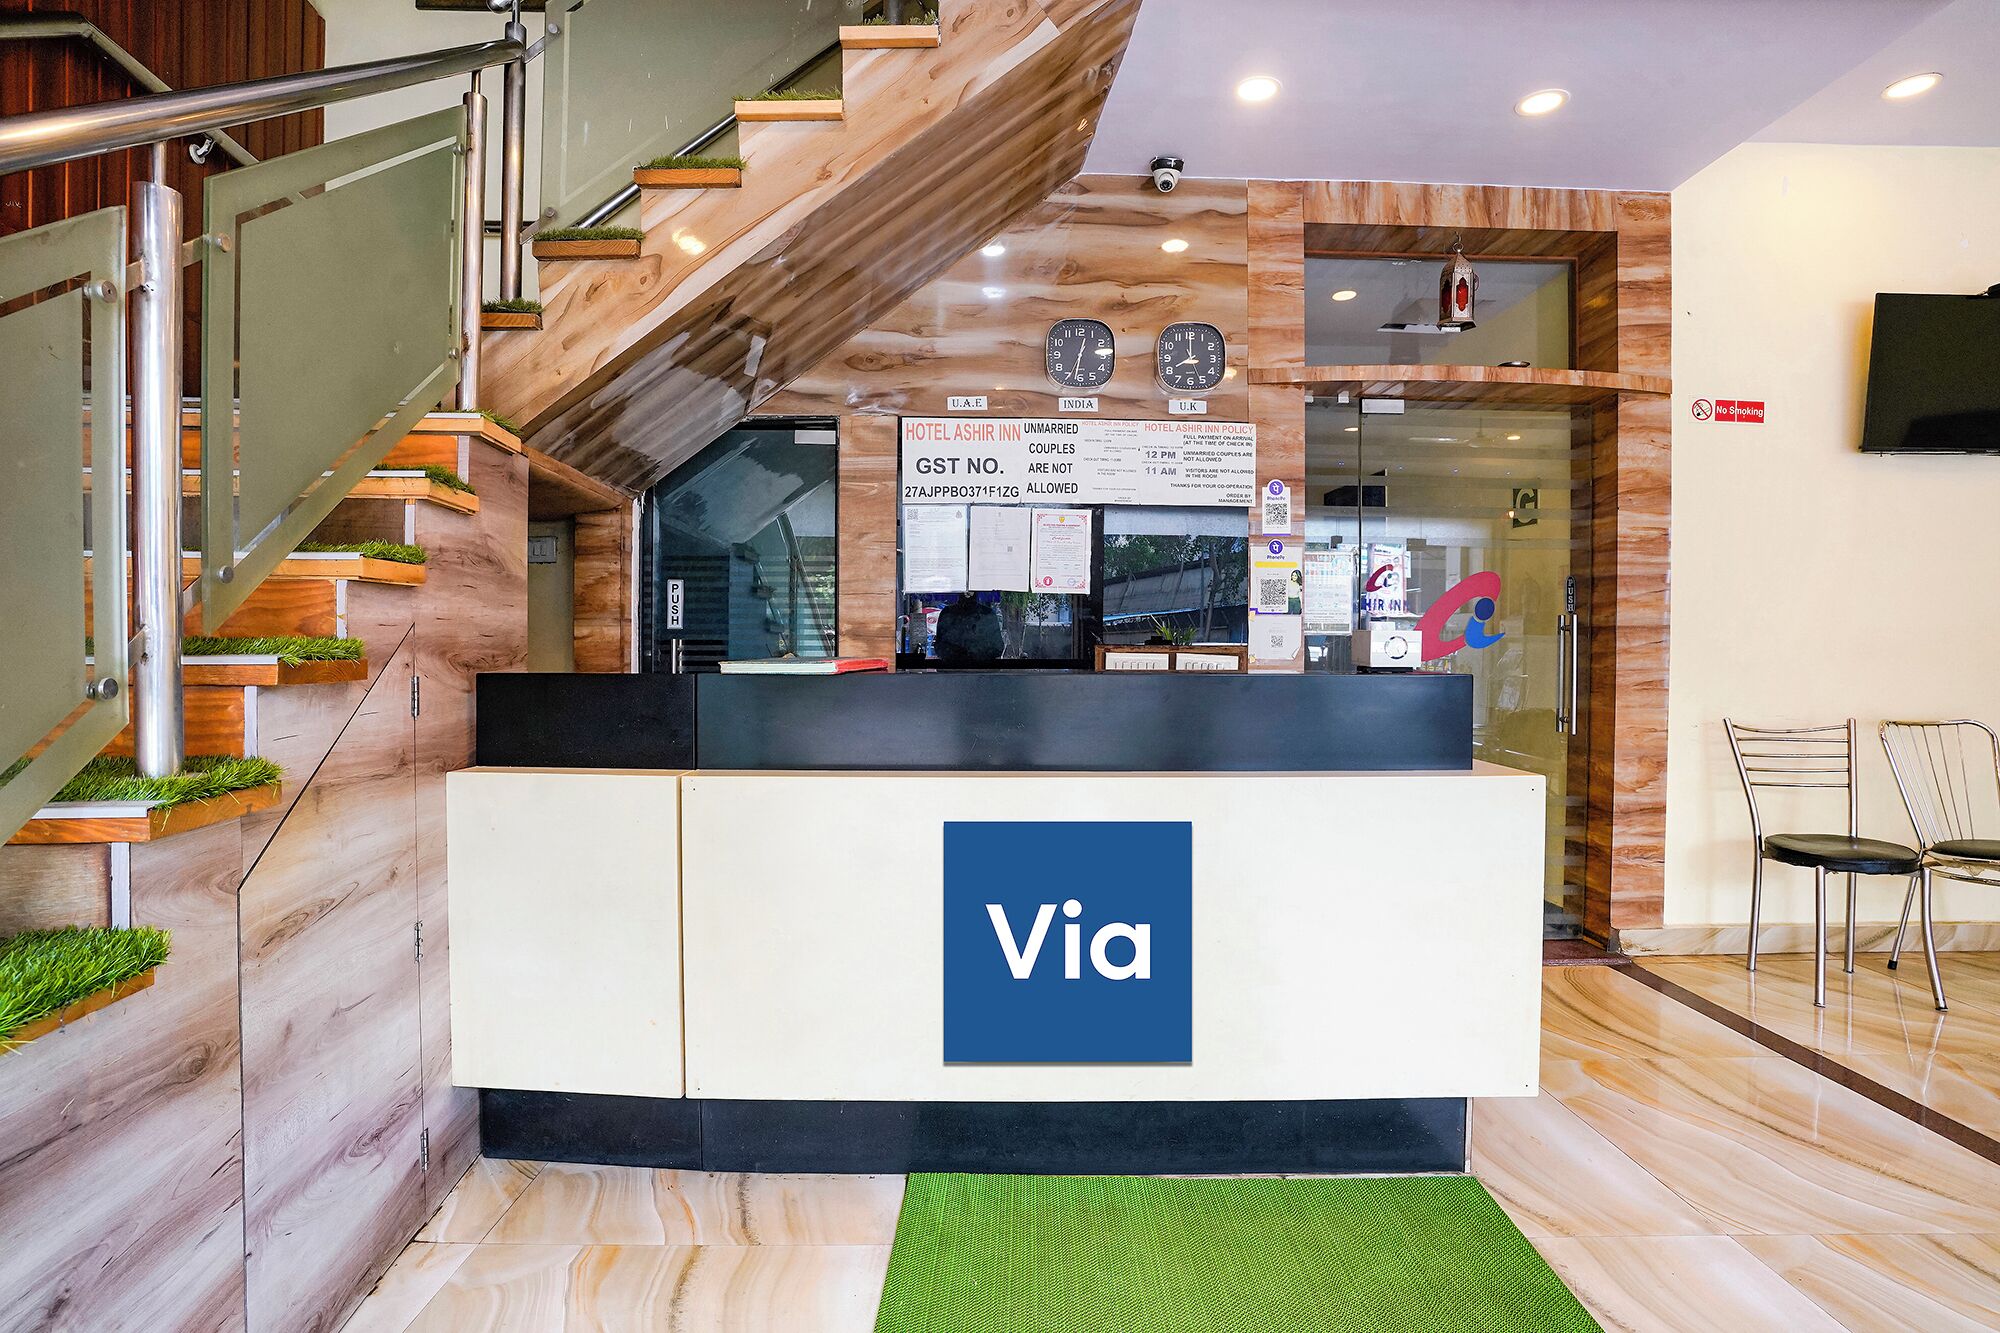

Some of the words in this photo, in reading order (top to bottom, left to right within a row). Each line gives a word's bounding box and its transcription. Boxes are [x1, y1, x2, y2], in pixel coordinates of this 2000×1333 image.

[1076, 328, 1085, 336] 12
[1091, 330, 1094, 338] 1
[1176, 333, 1181, 341] 11
[1200, 333, 1204, 342] 1
[1098, 339, 1104, 347] 2
[1165, 342, 1173, 350] 10
[1054, 351, 1060, 359] 9
[1164, 354, 1171, 362] 9
[1208, 367, 1215, 375] 4
[1065, 372, 1071, 380] 7
[1089, 372, 1096, 380] 5
[952, 399, 982, 408] U.A.E
[1064, 400, 1093, 408] INDIA
[1180, 402, 1197, 410] U.K
[1716, 406, 1727, 414] No
[1729, 406, 1763, 417] Smoking
[906, 423, 950, 440] HOTEL
[954, 424, 994, 441] ASHIR
[999, 424, 1021, 441] INN
[1024, 423, 1078, 434] UNMARRIED
[1145, 424, 1173, 432] HOTEL
[1176, 424, 1202, 433] ASHIR
[1205, 425, 1219, 433] INN
[1222, 425, 1253, 434] POLICY
[1029, 443, 1075, 454] COUPLES
[1161, 451, 1176, 459] PM
[916, 458, 960, 474] GST
[968, 458, 1004, 474] NO.
[1028, 463, 1048, 473] ARE
[1052, 463, 1072, 473] NOT
[1027, 483, 1078, 494] ALLOWED
[985, 899, 1151, 980] Via
